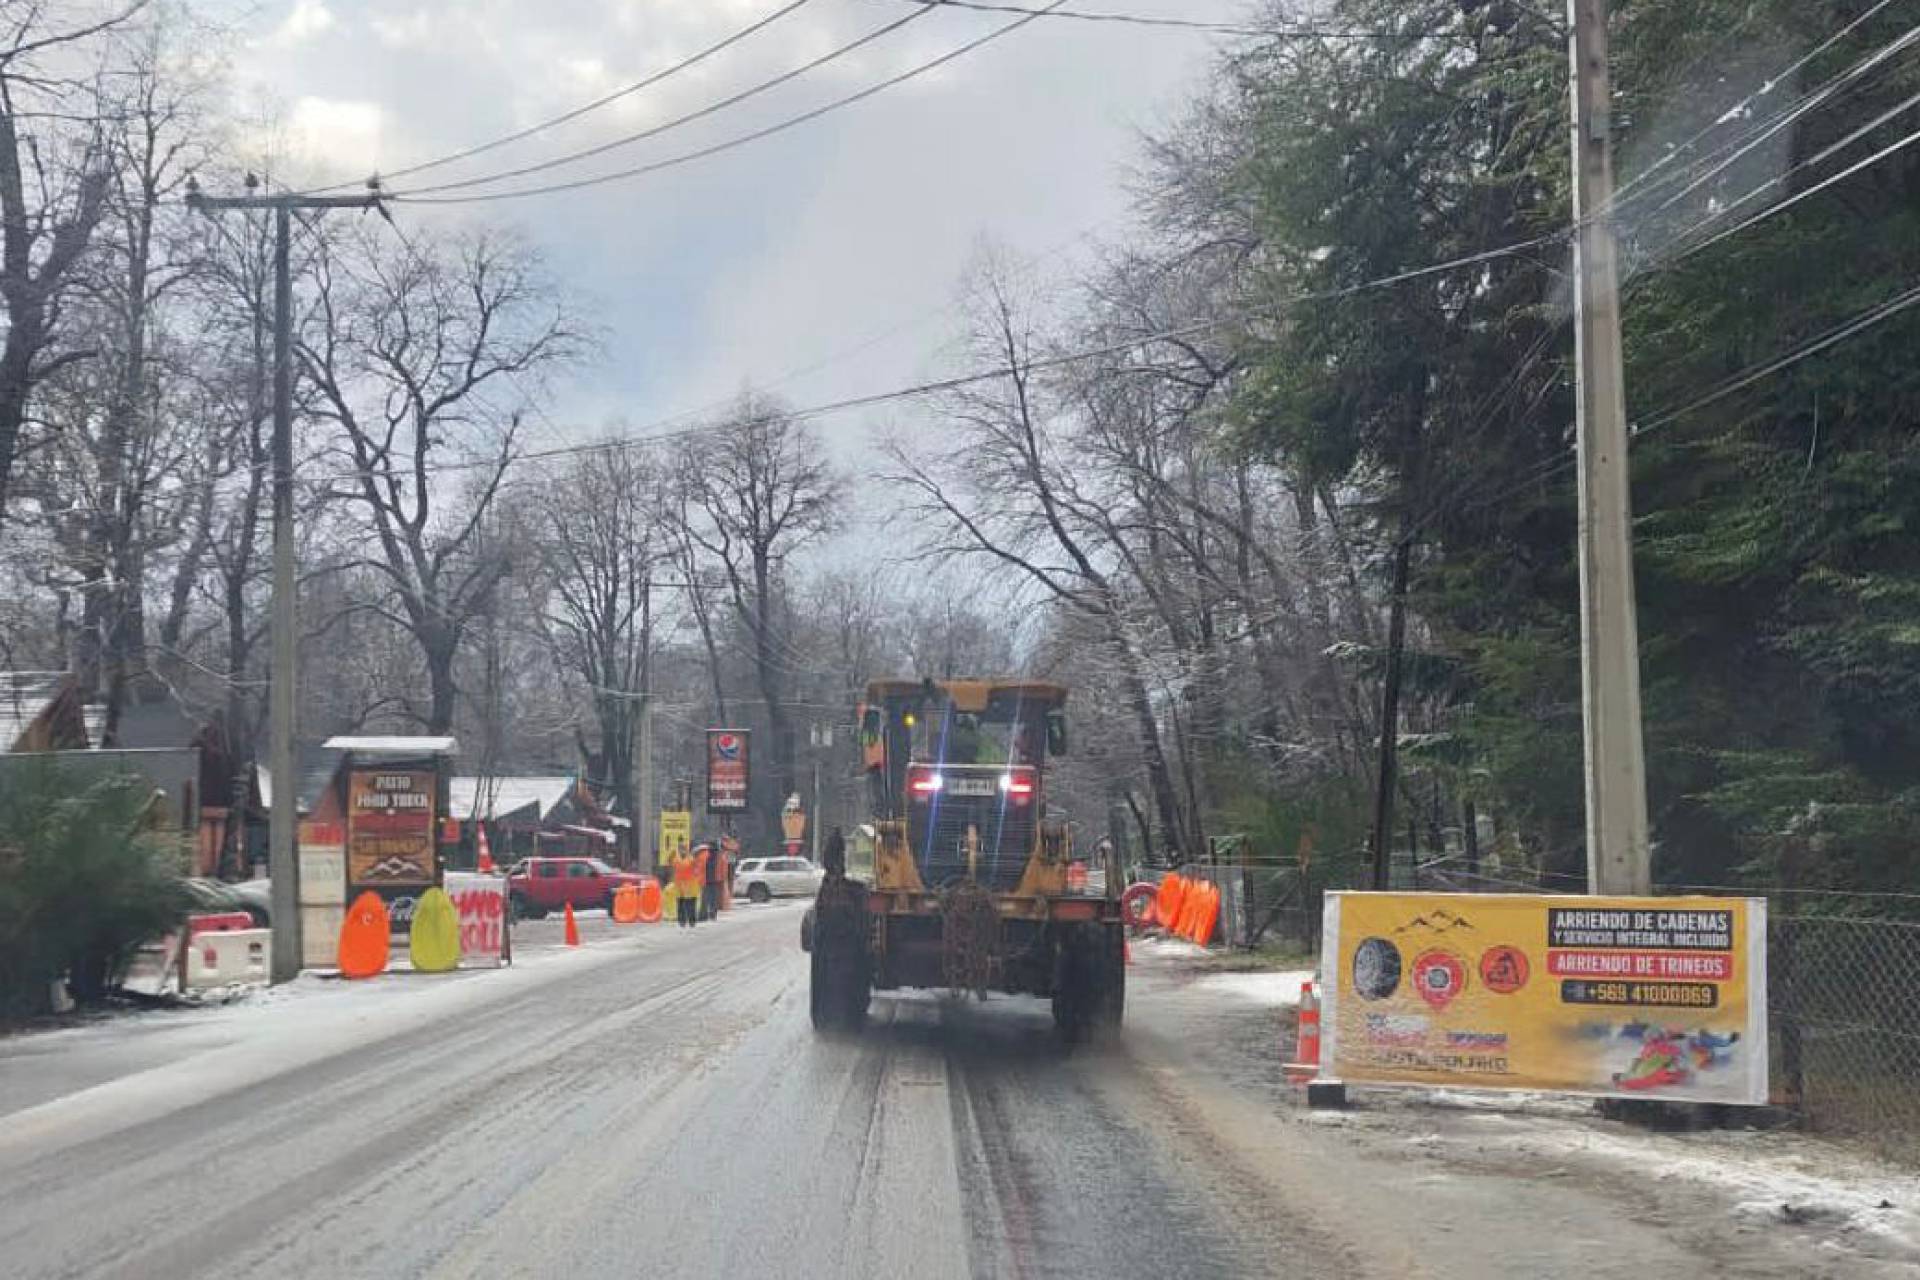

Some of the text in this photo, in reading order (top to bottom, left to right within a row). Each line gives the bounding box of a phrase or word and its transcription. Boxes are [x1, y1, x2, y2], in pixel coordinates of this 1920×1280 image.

[1555, 911, 1728, 931] ARRIENDO DE CADENAS
[1563, 930, 1614, 945] SERVICIO
[1616, 931, 1671, 946] INTEGRAL
[1673, 933, 1729, 947] INCLUIDO
[1556, 954, 1725, 976] ARRIENDO DE TRINEOS
[1587, 983, 1628, 1001] +569
